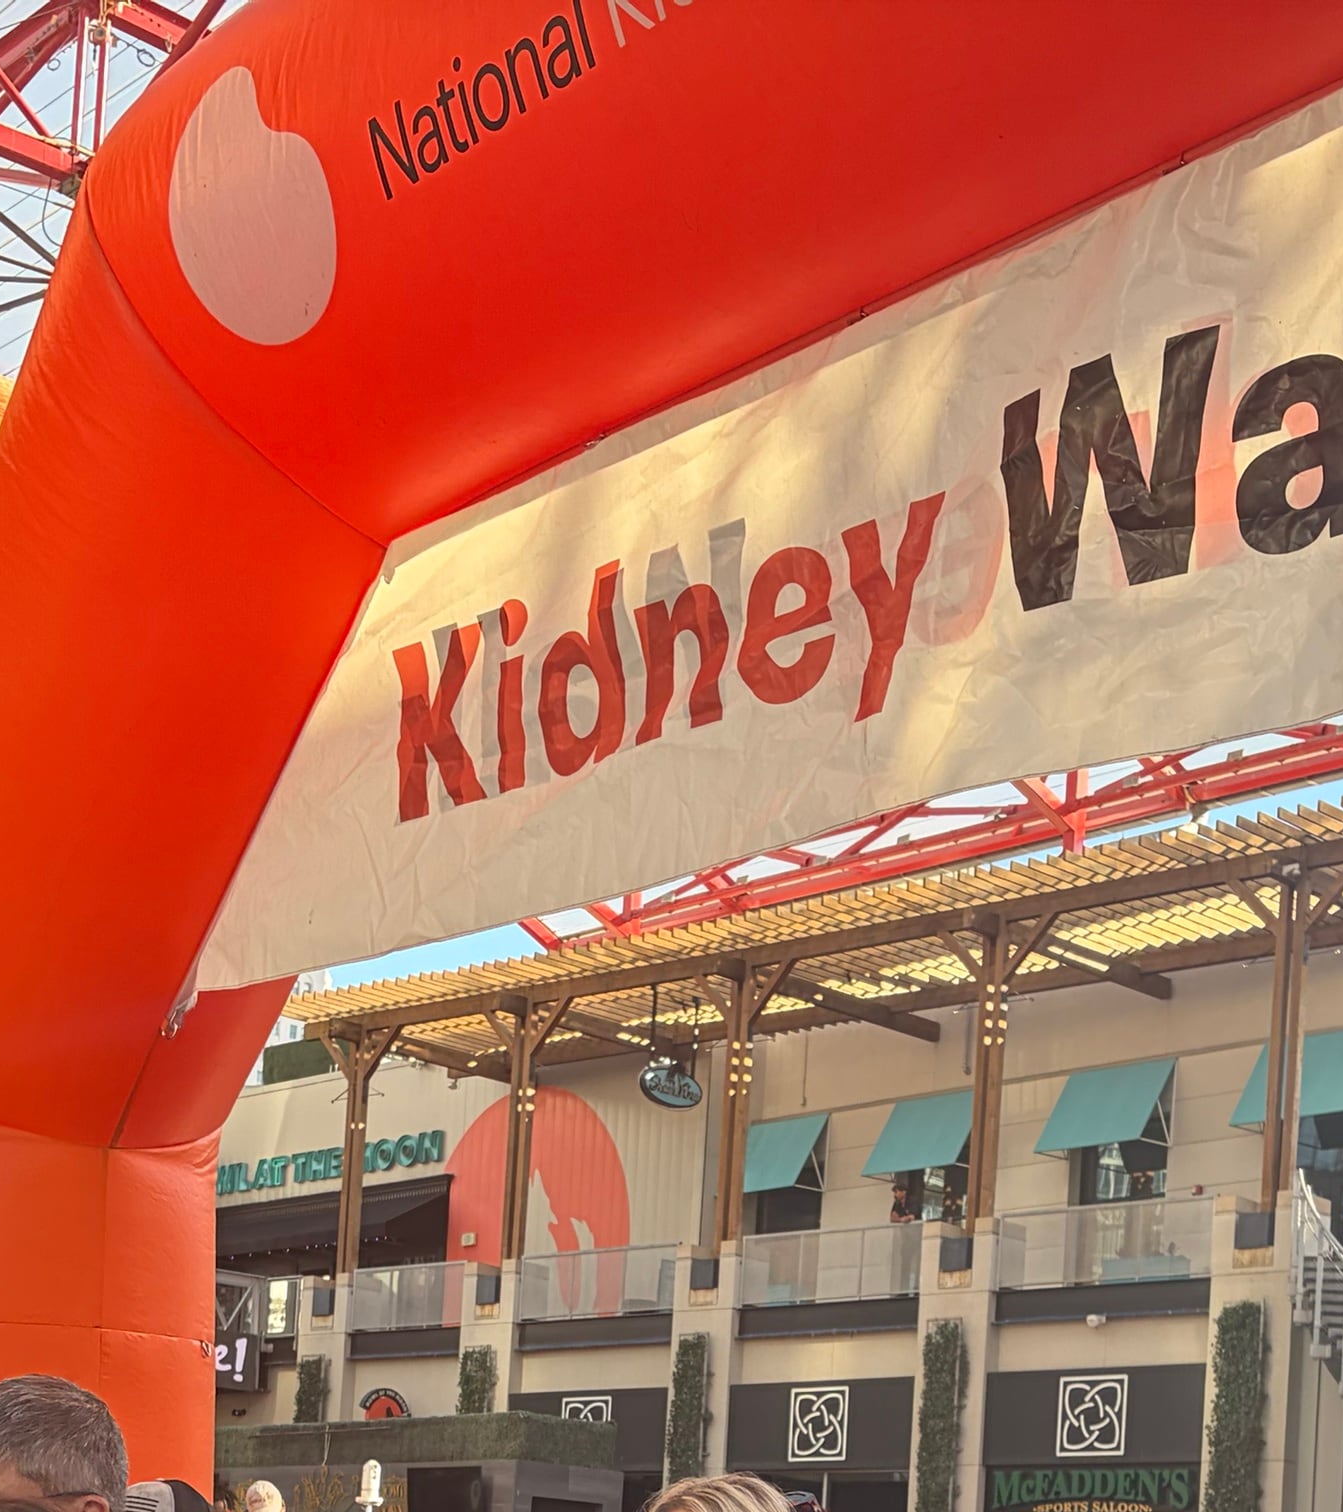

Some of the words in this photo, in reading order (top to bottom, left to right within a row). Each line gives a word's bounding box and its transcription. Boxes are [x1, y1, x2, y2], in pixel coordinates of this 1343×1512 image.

[367, 0, 596, 201] National
[394, 491, 945, 824] Kidney
[255, 1156, 290, 1189] AT
[292, 1147, 343, 1183] THE
[992, 1468, 1191, 1511] McFADDEN'S
